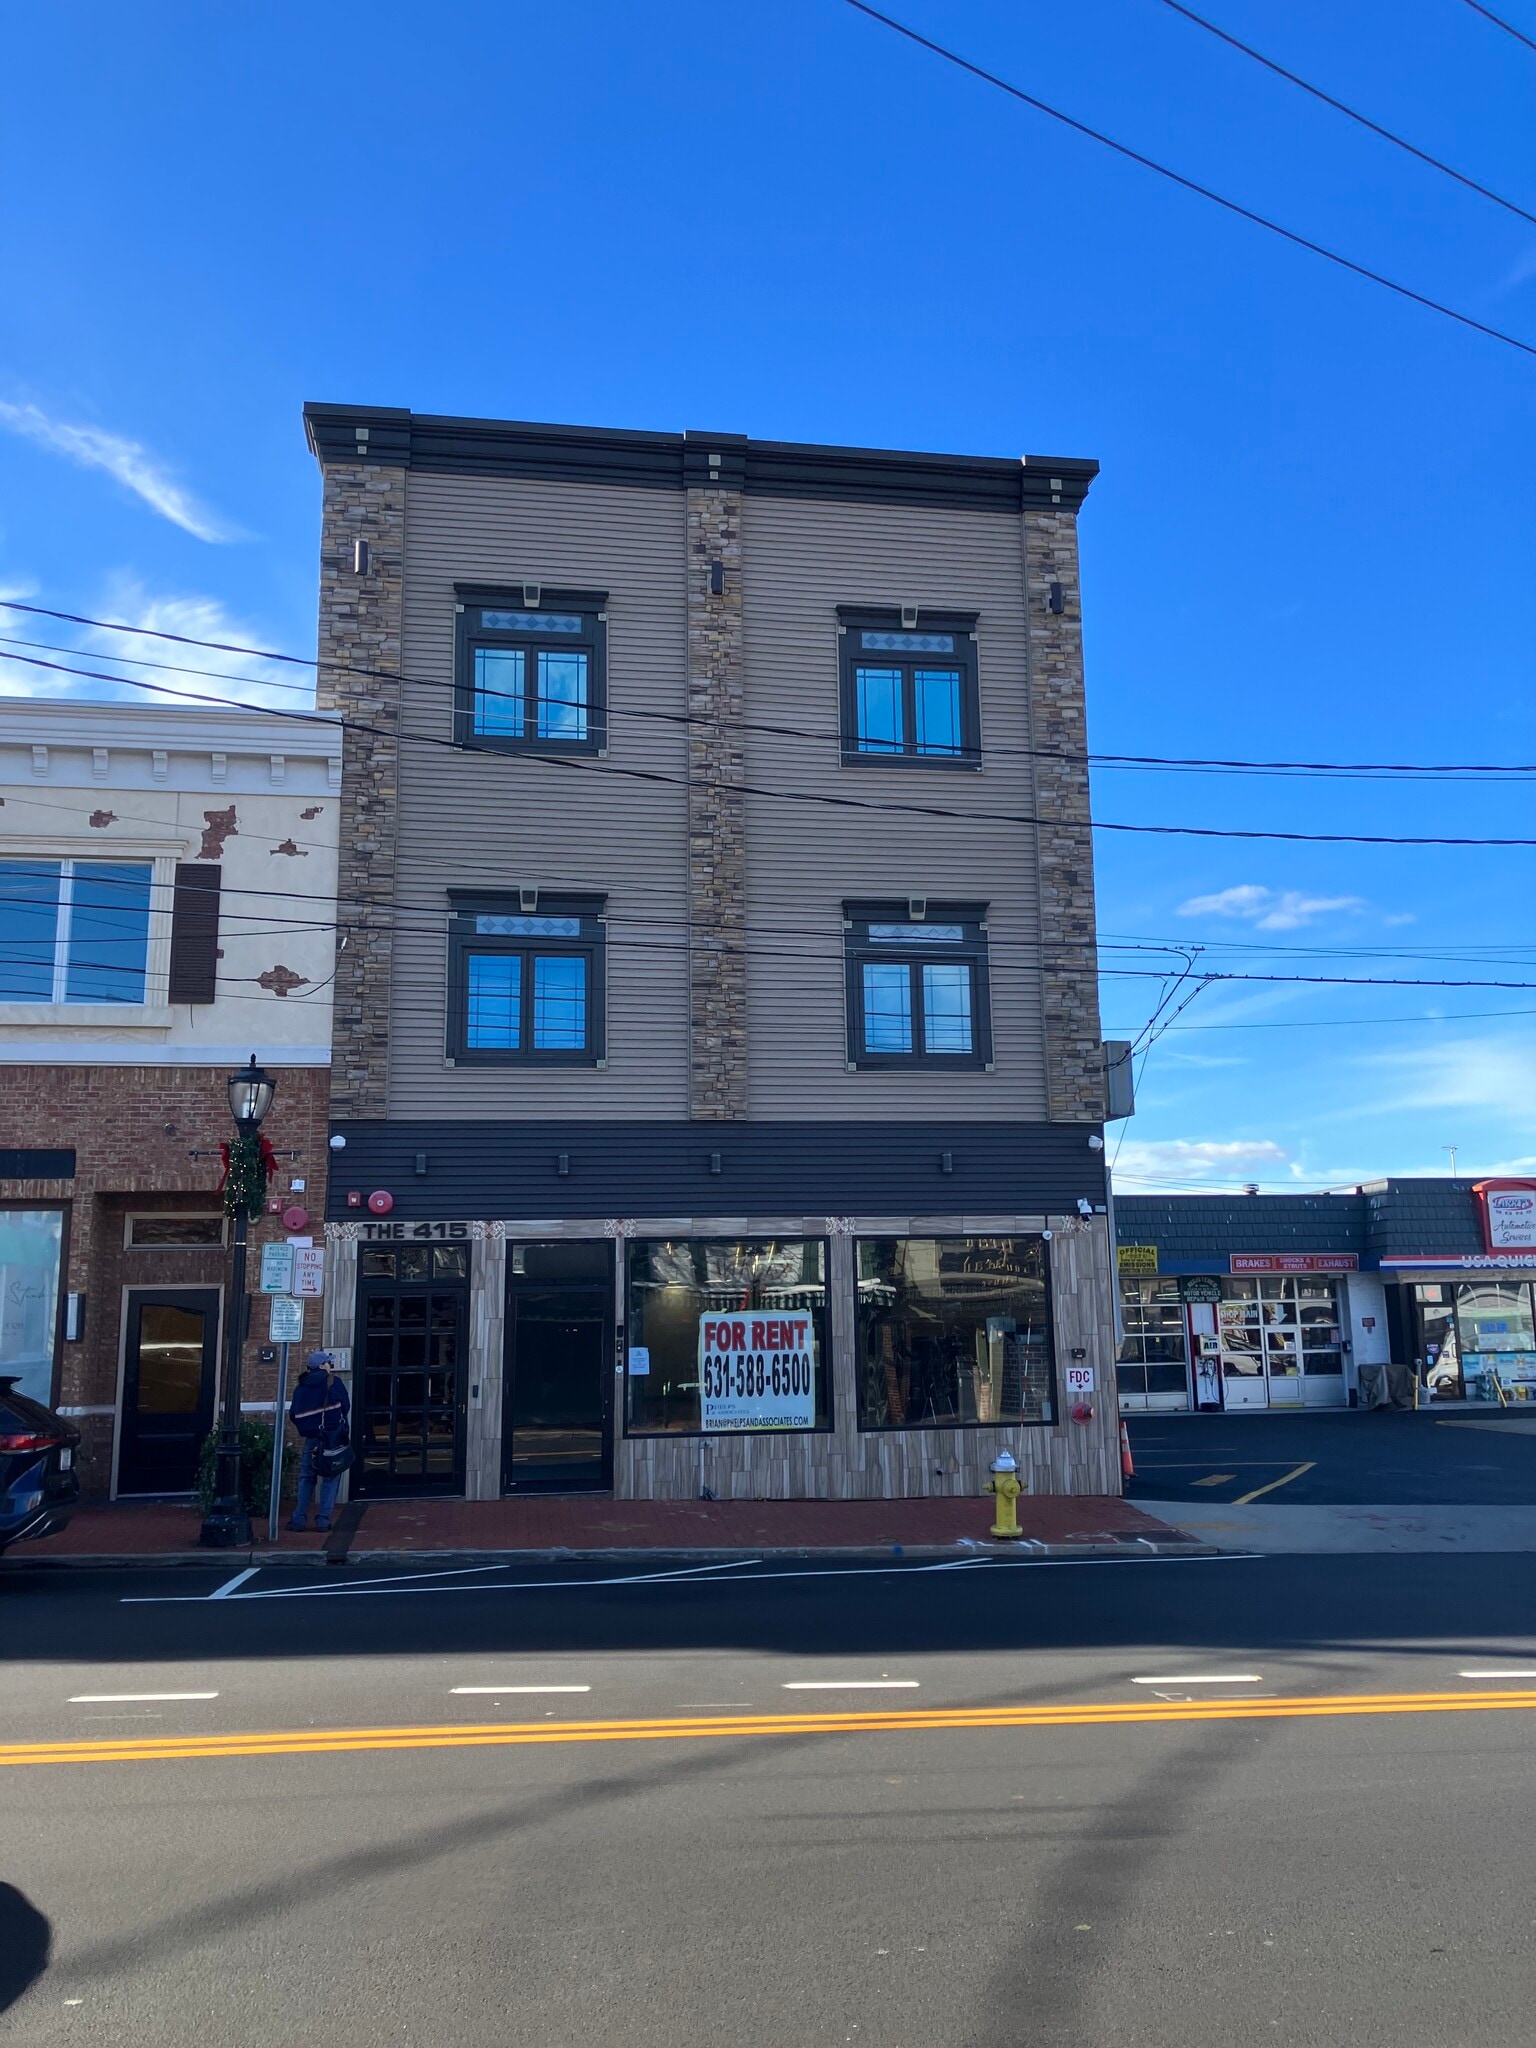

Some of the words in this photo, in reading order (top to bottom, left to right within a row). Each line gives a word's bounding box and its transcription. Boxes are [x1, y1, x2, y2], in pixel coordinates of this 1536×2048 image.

[362, 1223, 405, 1239] THE
[413, 1222, 467, 1239] 415
[1500, 1231, 1532, 1244] Services
[304, 1252, 317, 1262] NO
[1119, 1247, 1155, 1256] OFFICIAL
[1235, 1259, 1271, 1268] BRAKES
[1318, 1259, 1354, 1268] EXHAUST
[1461, 1255, 1494, 1268] USA
[301, 1279, 316, 1287] TIME
[704, 1321, 747, 1352] FOR
[751, 1320, 808, 1351] RENT
[1203, 1342, 1218, 1350] AIR
[704, 1353, 810, 1398] 631-588-6500
[1069, 1370, 1090, 1383] FDC
